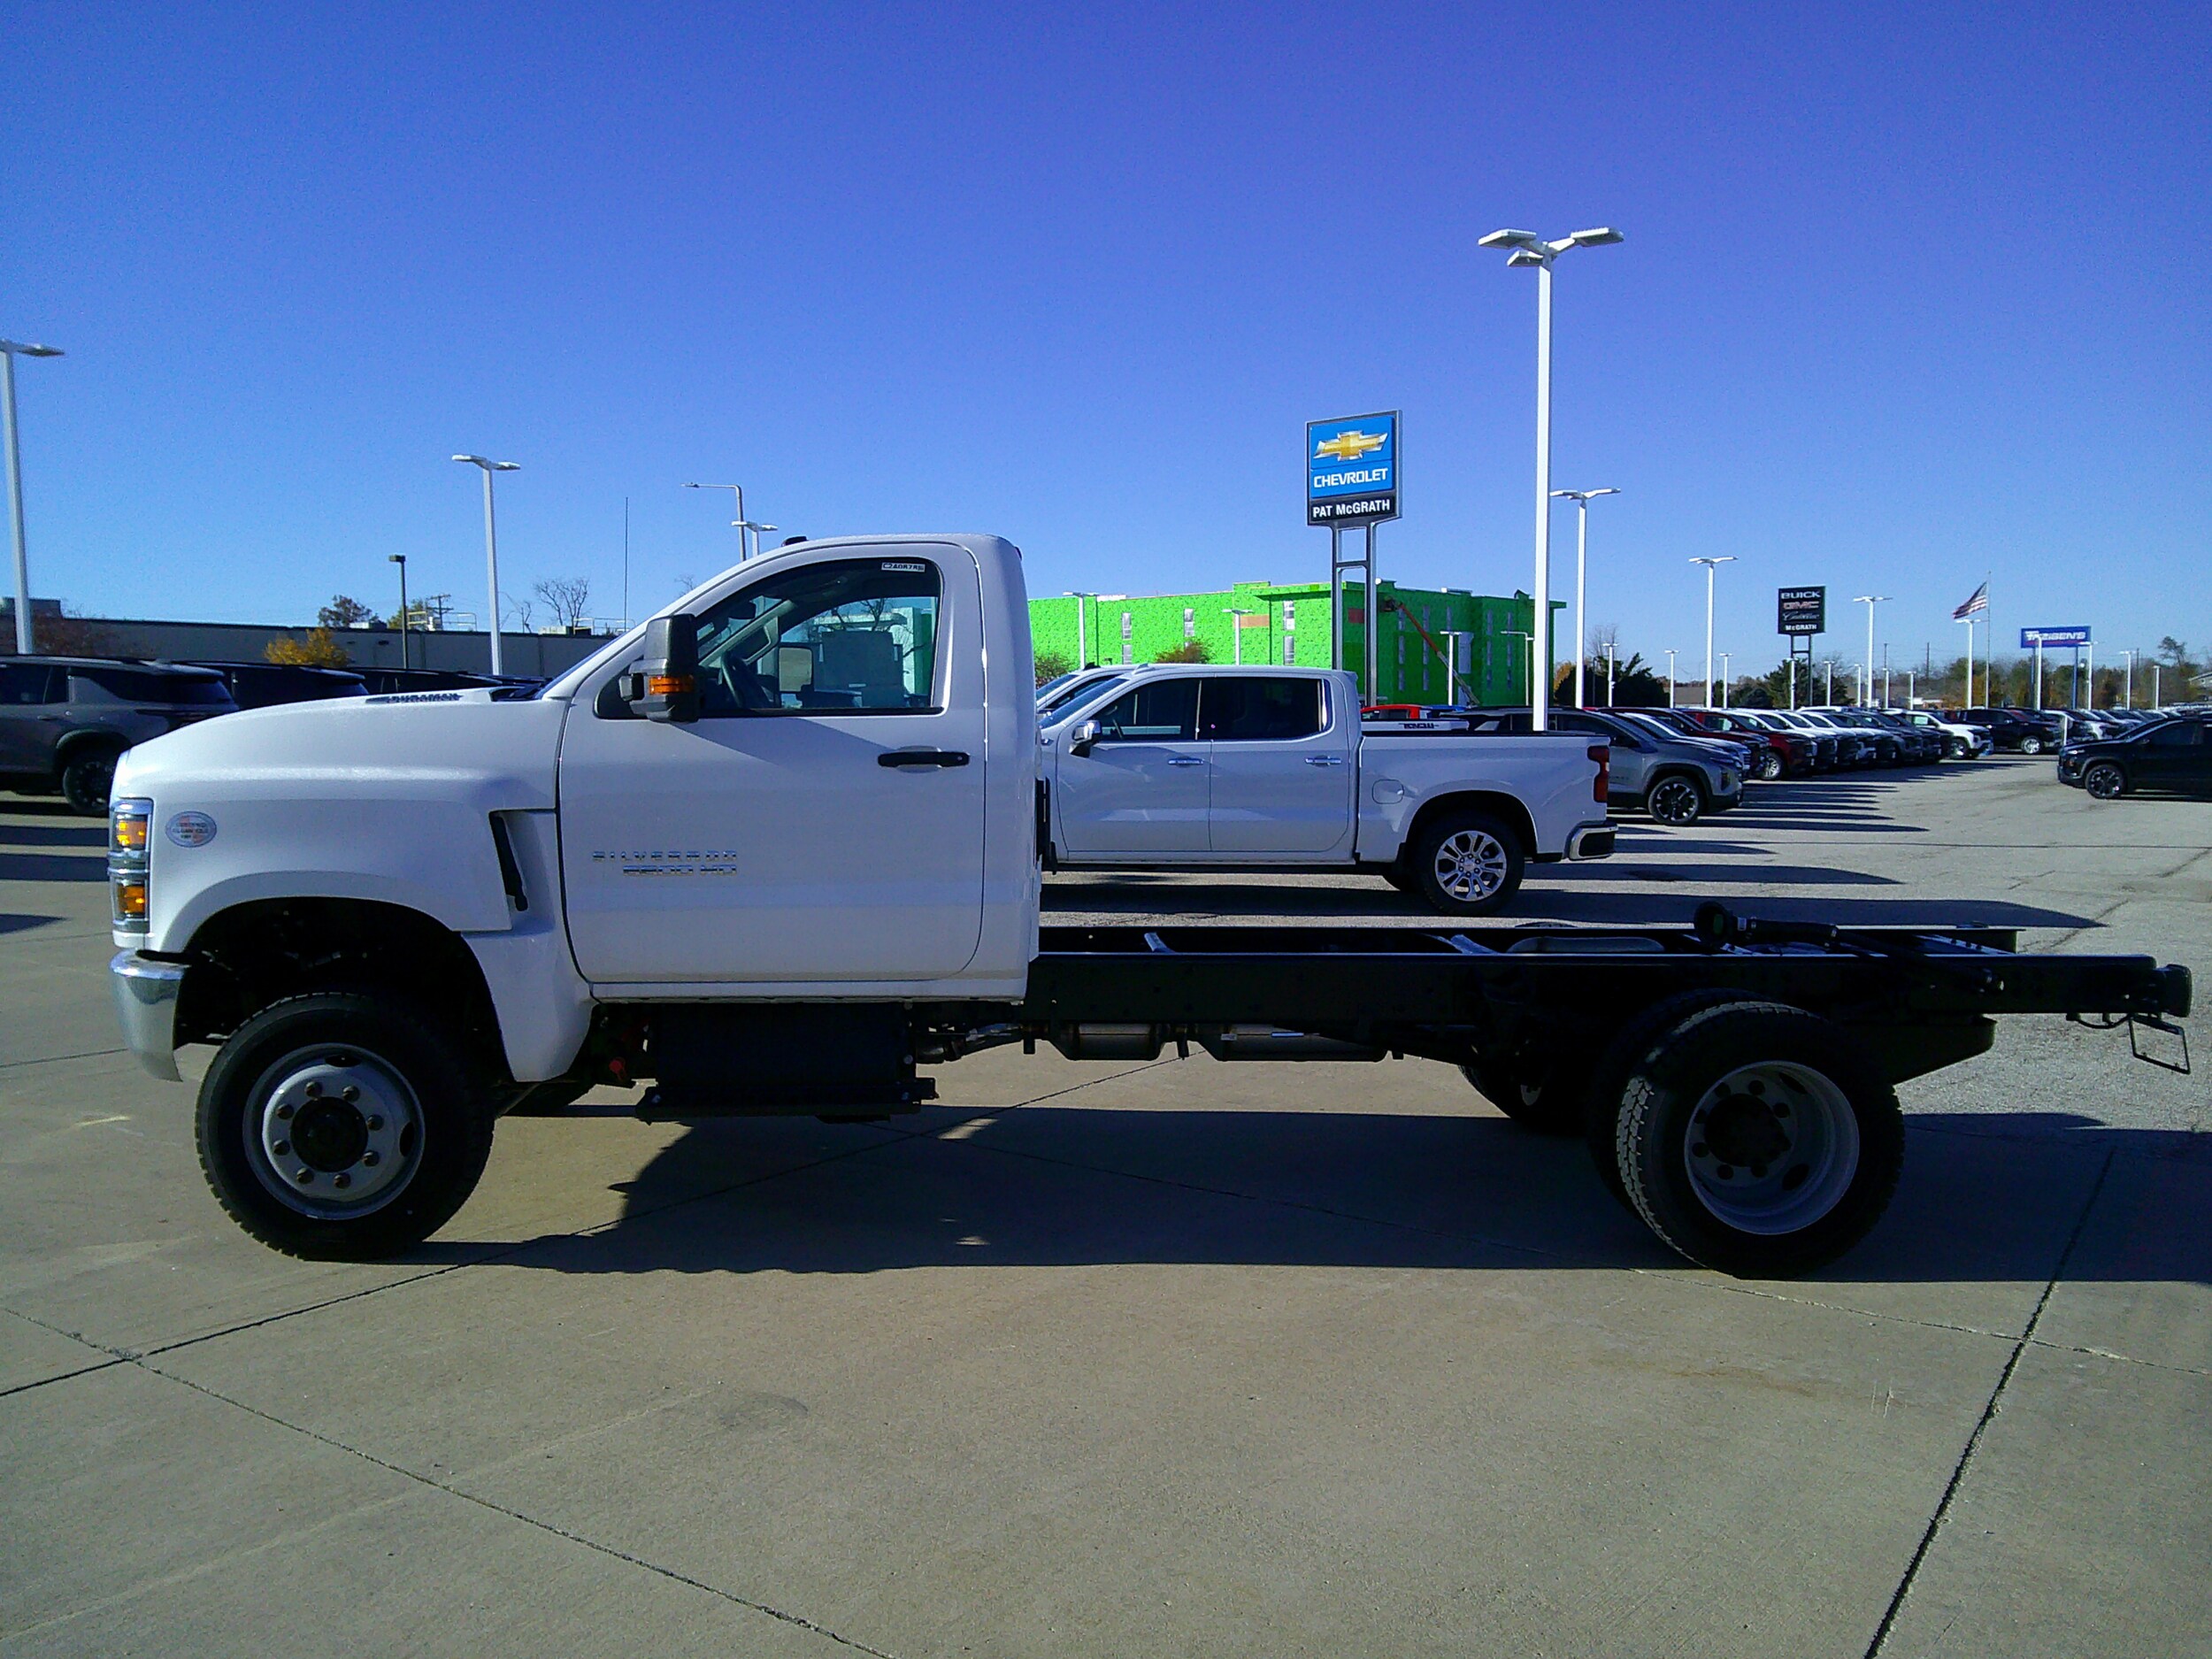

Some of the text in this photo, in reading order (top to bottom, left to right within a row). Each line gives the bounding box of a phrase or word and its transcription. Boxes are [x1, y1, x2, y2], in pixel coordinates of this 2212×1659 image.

[1314, 468, 1388, 488] CHEVROLET
[1313, 499, 1391, 518] PAT McGRATH
[1783, 601, 1819, 610] GMC
[593, 851, 737, 862] SILVERADO
